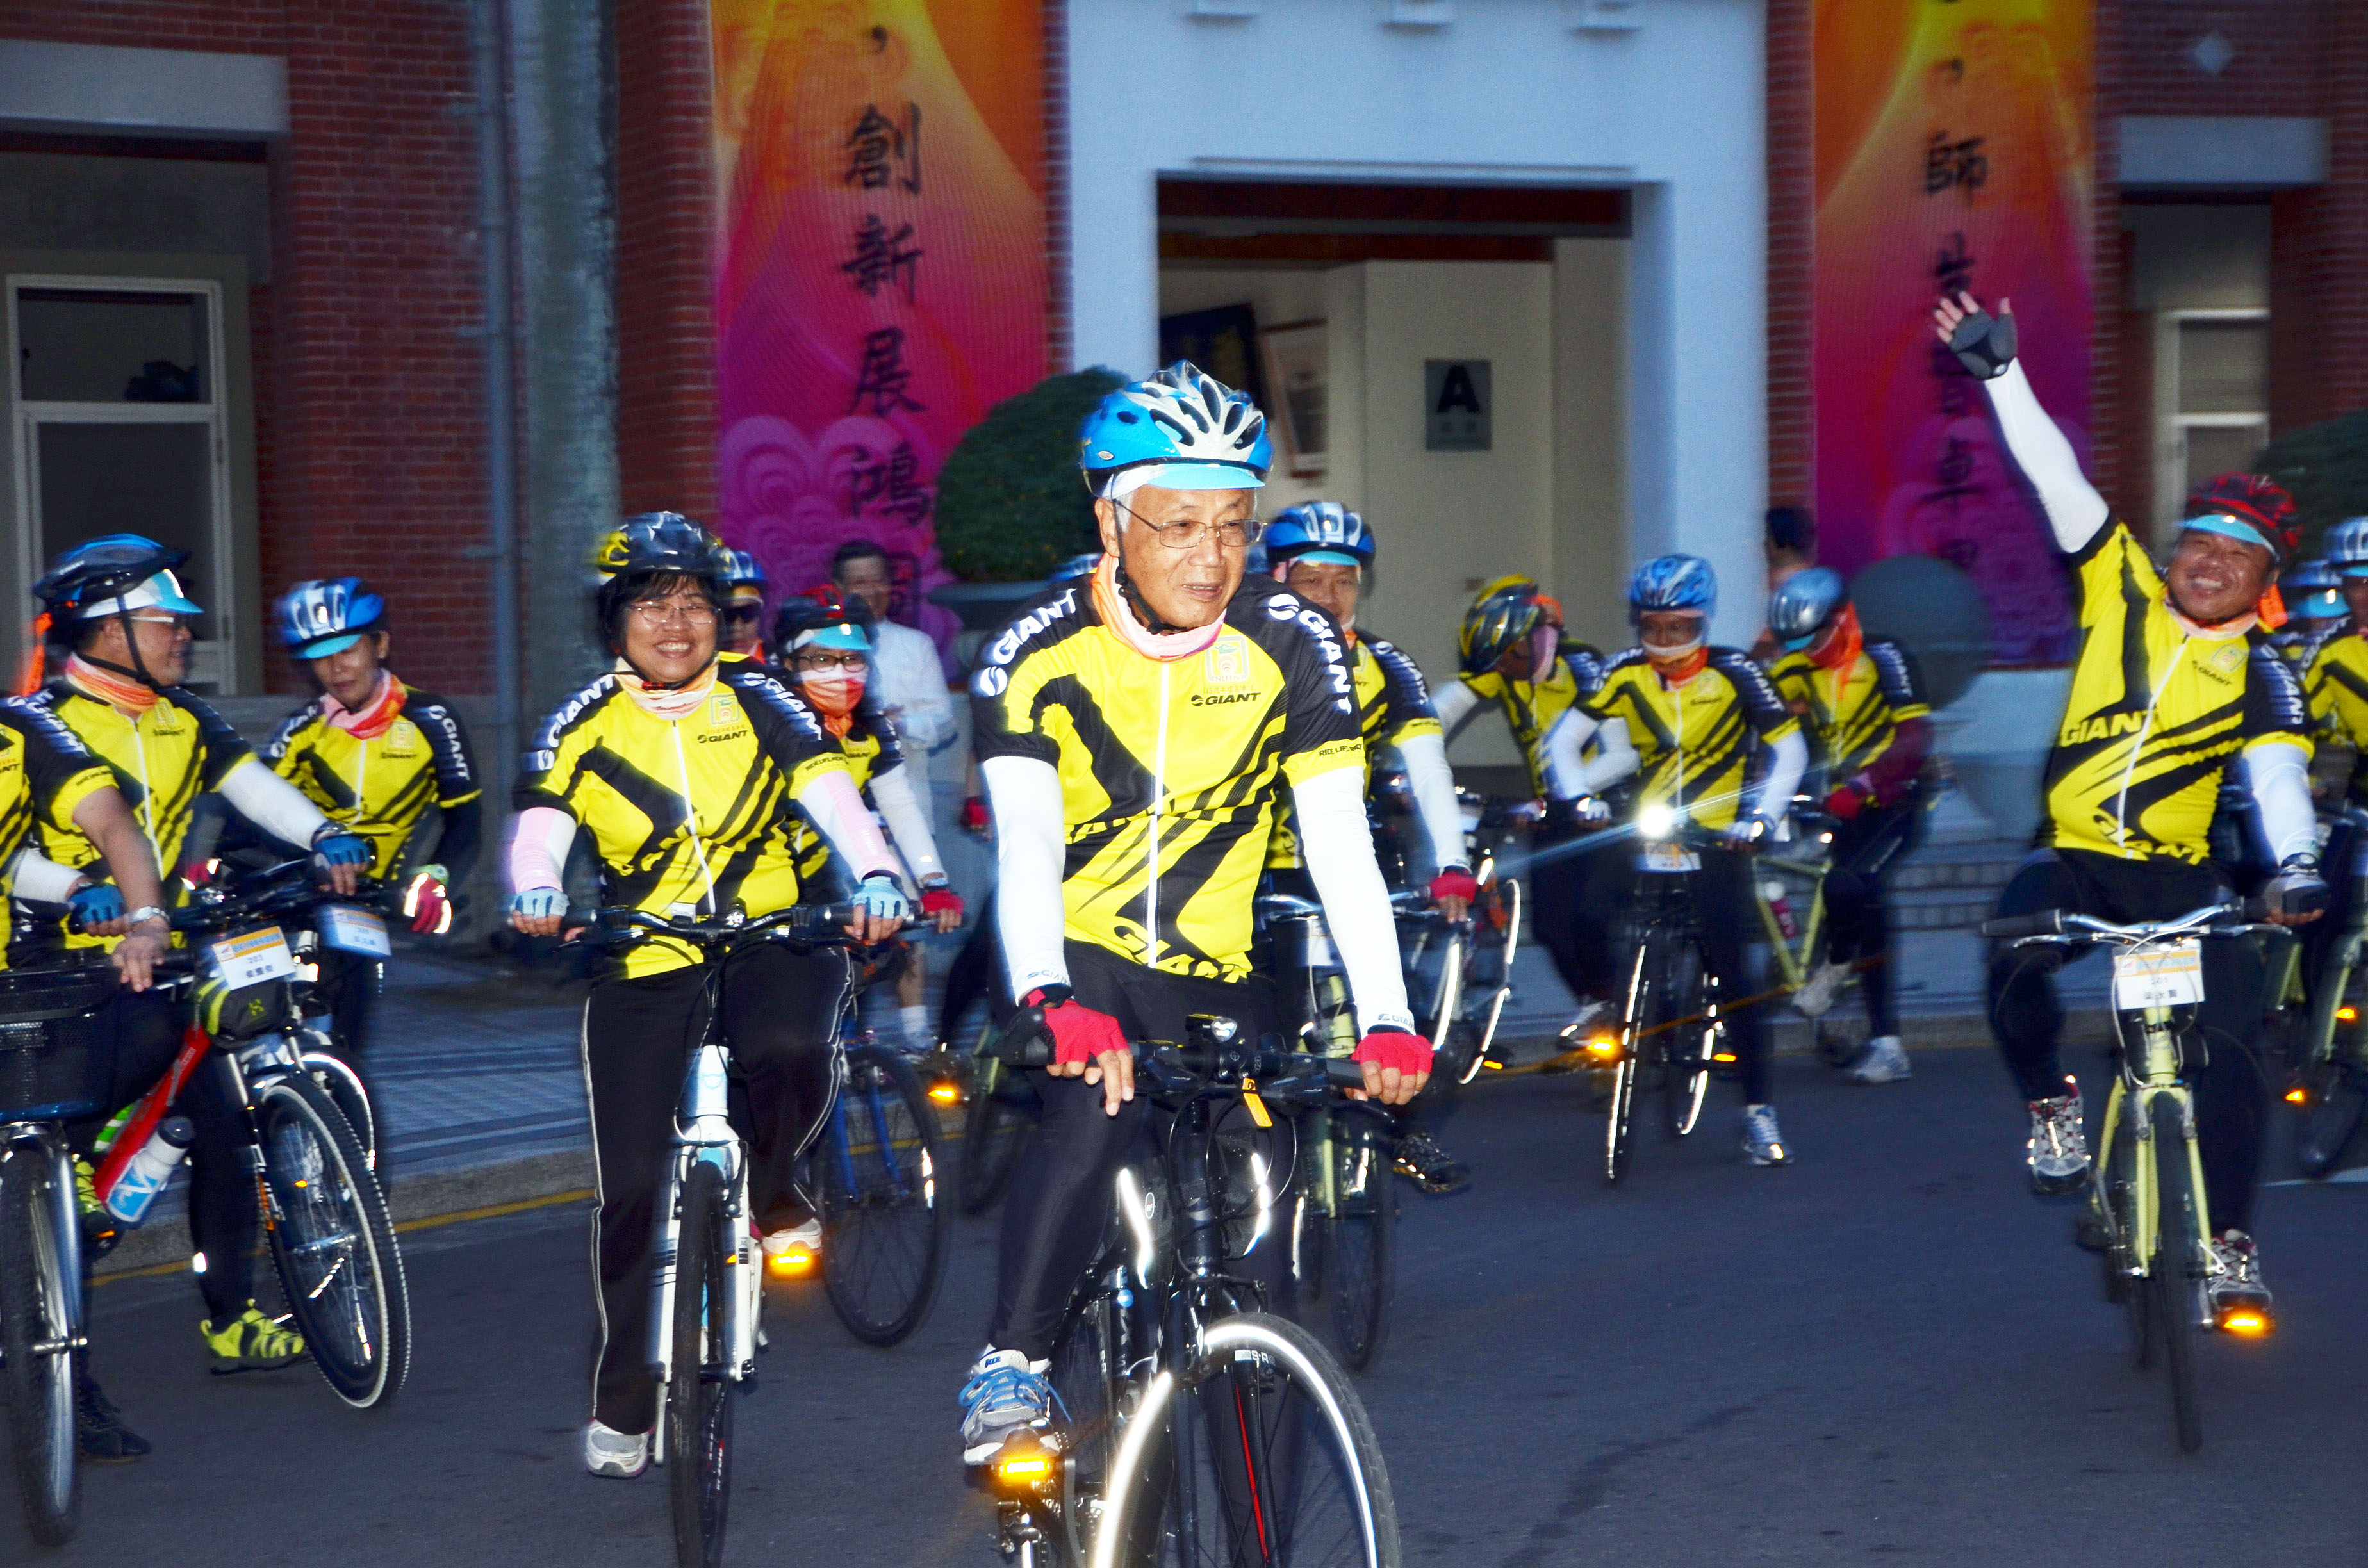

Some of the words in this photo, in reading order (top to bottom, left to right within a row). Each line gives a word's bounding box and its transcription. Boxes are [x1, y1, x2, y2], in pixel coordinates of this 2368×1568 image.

[1436, 364, 1481, 413] A
[994, 588, 1077, 664] GIANT
[1299, 610, 1352, 715] GIANT
[548, 674, 616, 748] GIANT
[1205, 692, 1261, 705] GIANT
[441, 717, 470, 781] GIANT
[709, 730, 748, 742] GIANT
[1319, 749, 1335, 757] RIDE
[1041, 970, 1067, 984] GIAN
[1392, 1015, 1413, 1029] GIAN
